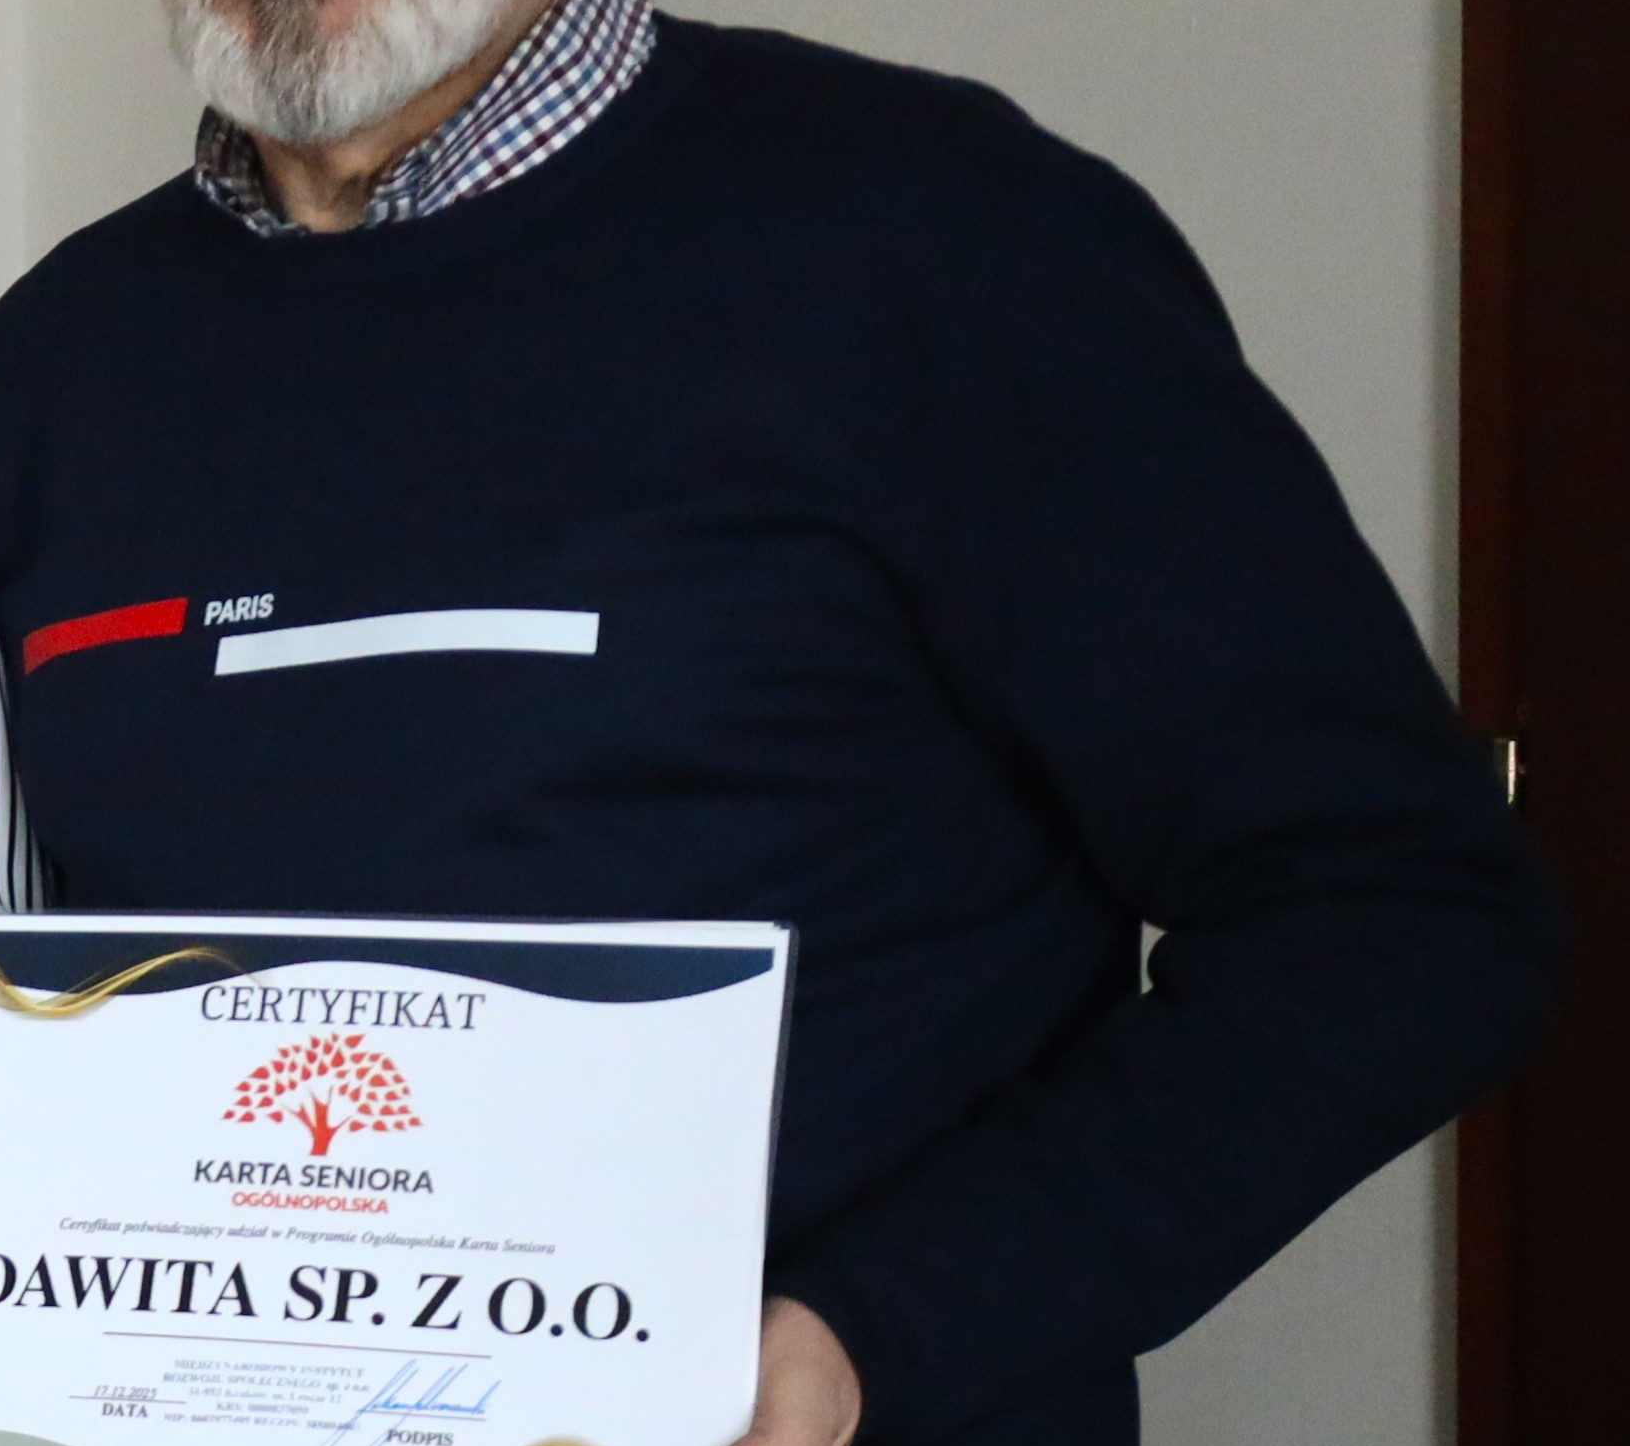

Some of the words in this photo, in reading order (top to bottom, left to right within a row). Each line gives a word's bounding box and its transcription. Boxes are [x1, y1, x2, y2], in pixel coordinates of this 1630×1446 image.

[204, 593, 275, 626] PARIS
[201, 984, 486, 1030] CERTYFIKAT
[194, 1159, 293, 1187] KARTA
[299, 1164, 434, 1194] SENIORA
[231, 1190, 389, 1215] OGÓLNOPOLSKA
[59, 1216, 121, 1234] Certyfikat
[271, 1229, 283, 1238] w
[285, 1227, 358, 1244] Programie
[361, 1231, 456, 1250] Ogólnopolska
[460, 1237, 498, 1252] Karta
[503, 1239, 556, 1255] Seniora
[283, 1264, 385, 1326] SP.
[411, 1273, 465, 1330] Z
[488, 1276, 651, 1342] O.O.
[94, 1385, 157, 1399] 17.12.2025
[101, 1402, 149, 1419] DATA
[387, 1427, 454, 1446] PODPIS
